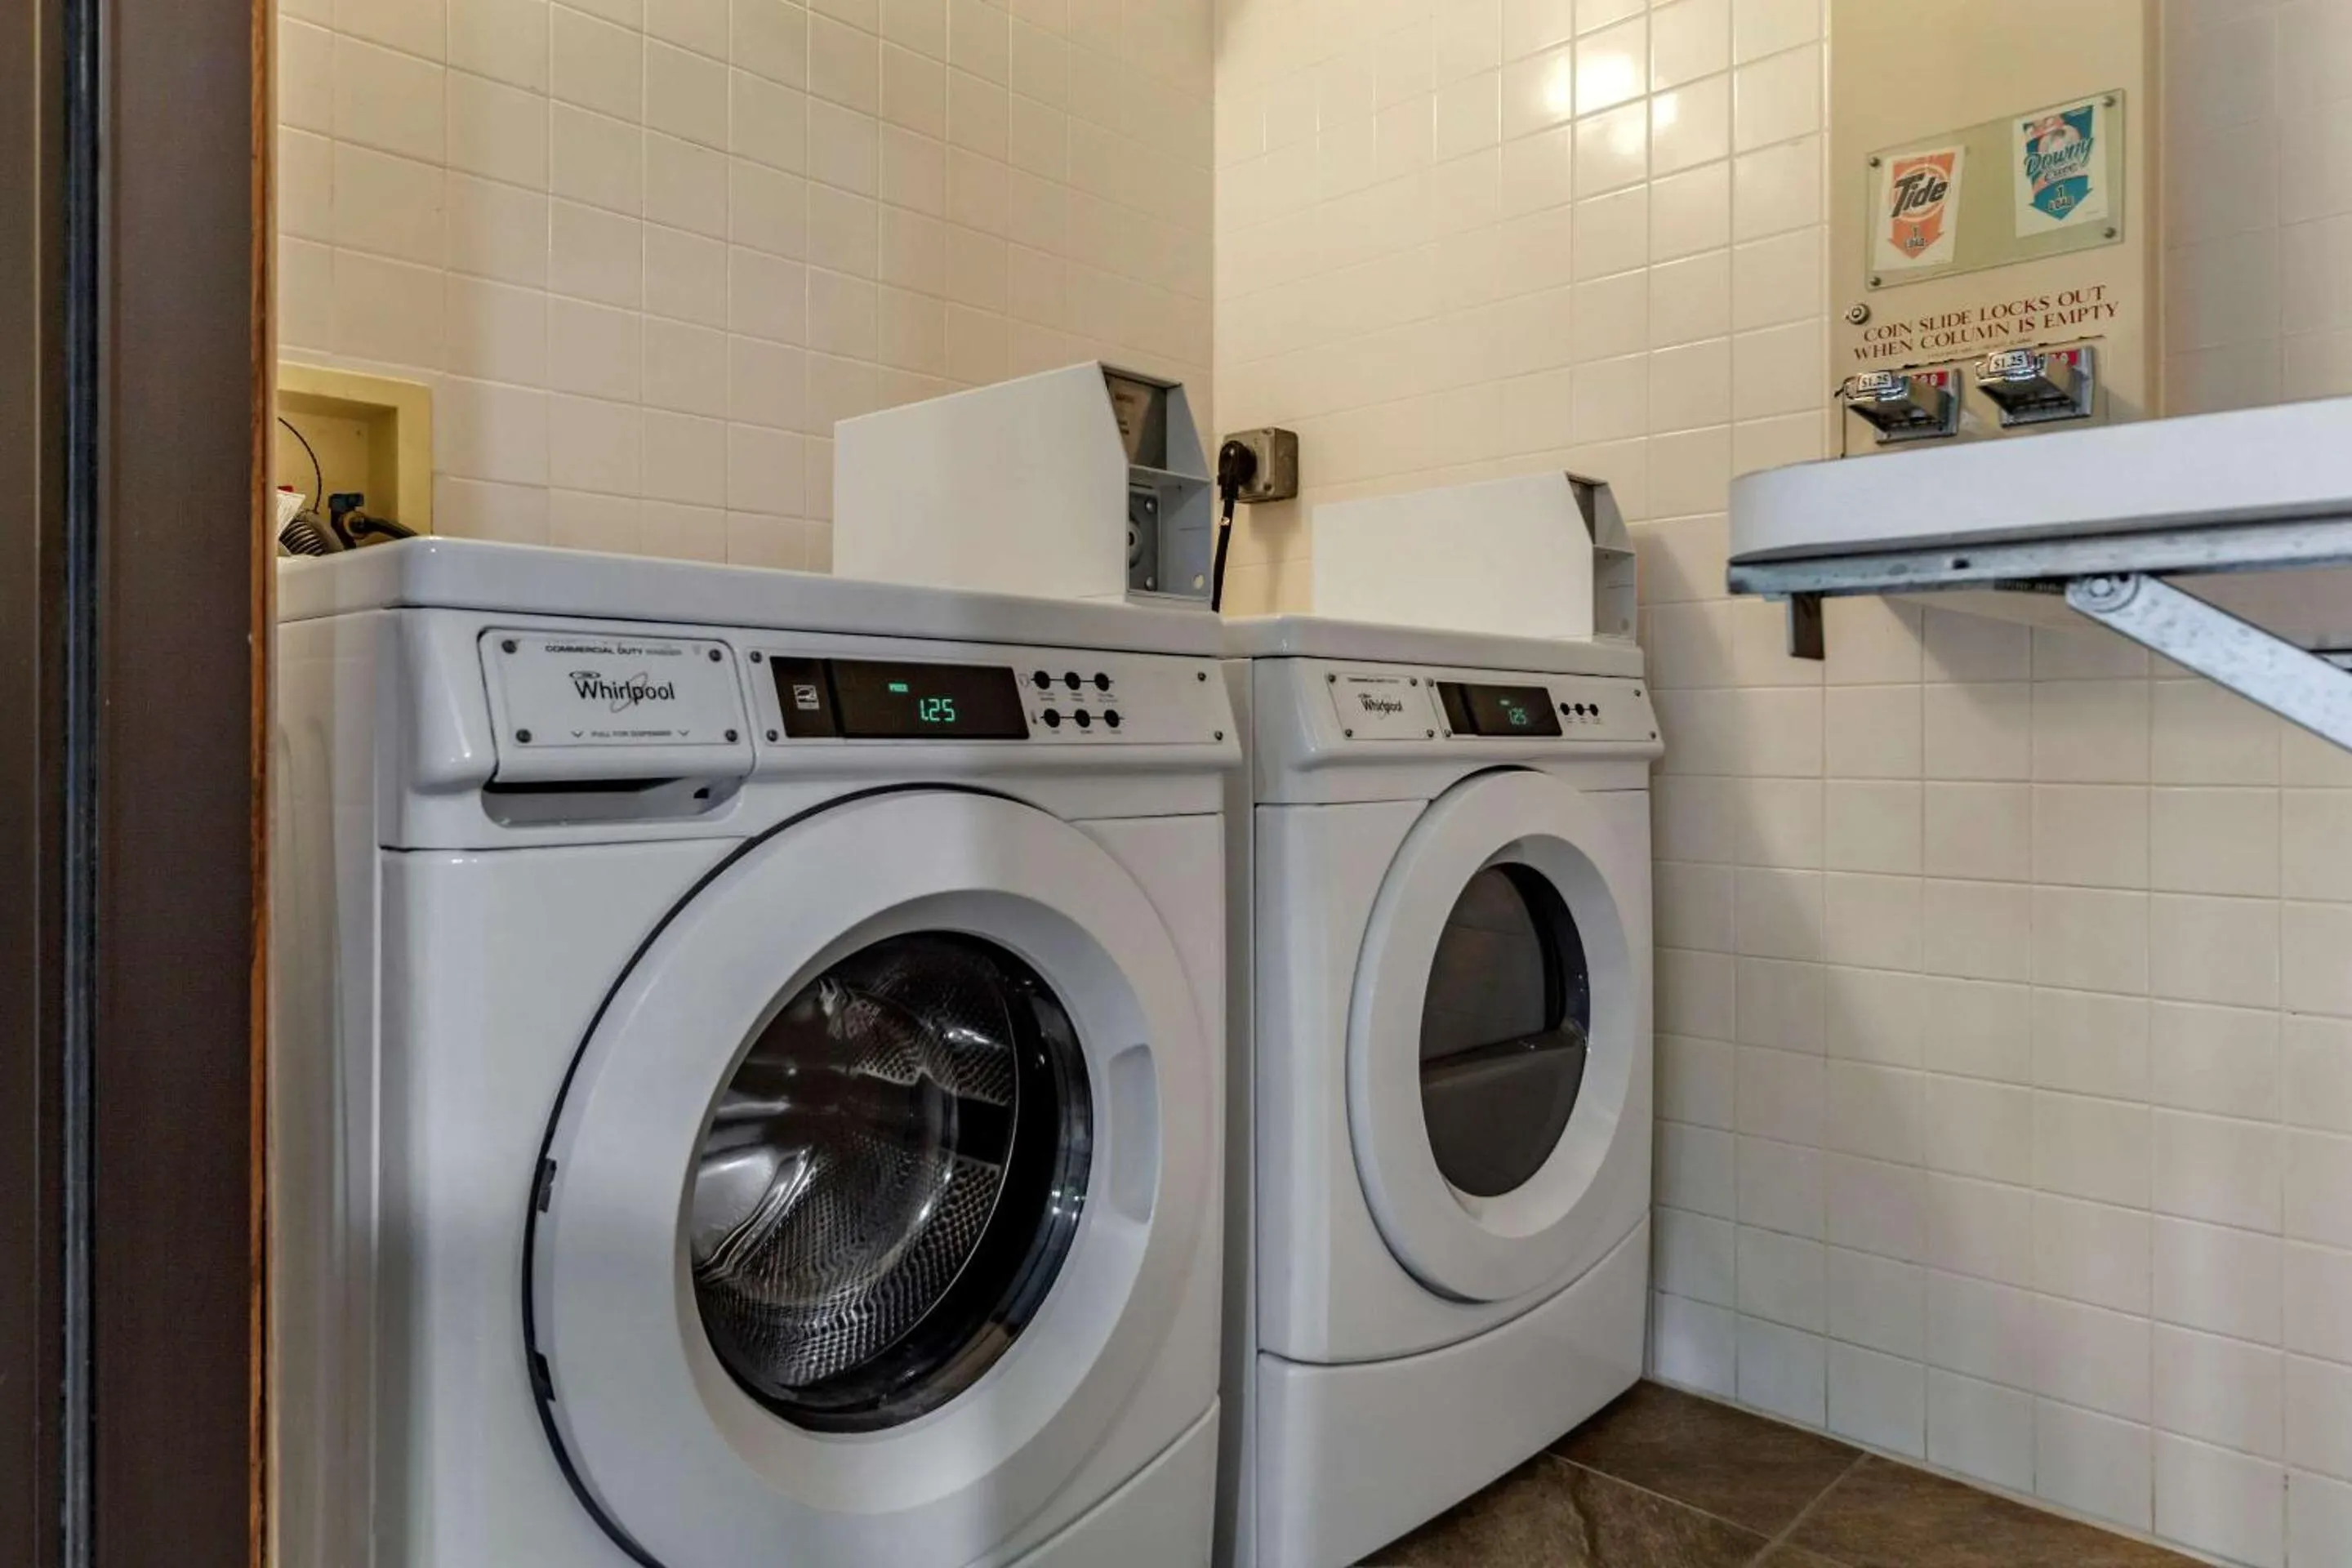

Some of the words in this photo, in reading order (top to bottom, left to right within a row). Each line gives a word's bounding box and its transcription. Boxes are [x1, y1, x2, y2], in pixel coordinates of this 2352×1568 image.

[2024, 137, 2094, 177] Downy
[1891, 172, 1949, 217] Tide
[1854, 339, 1912, 360] WHEN
[1921, 321, 2009, 349] COLUMN
[2019, 316, 2034, 333] IS
[2044, 301, 2119, 328] EMPTY
[1864, 320, 1912, 342] COIN
[1919, 310, 1973, 332] SLIDE
[1980, 296, 2050, 321] LOCKS
[2058, 285, 2106, 307] OUT
[1861, 374, 1889, 388] $1.25
[1993, 355, 2024, 369] $1.25
[574, 680, 675, 706] Whirlpool
